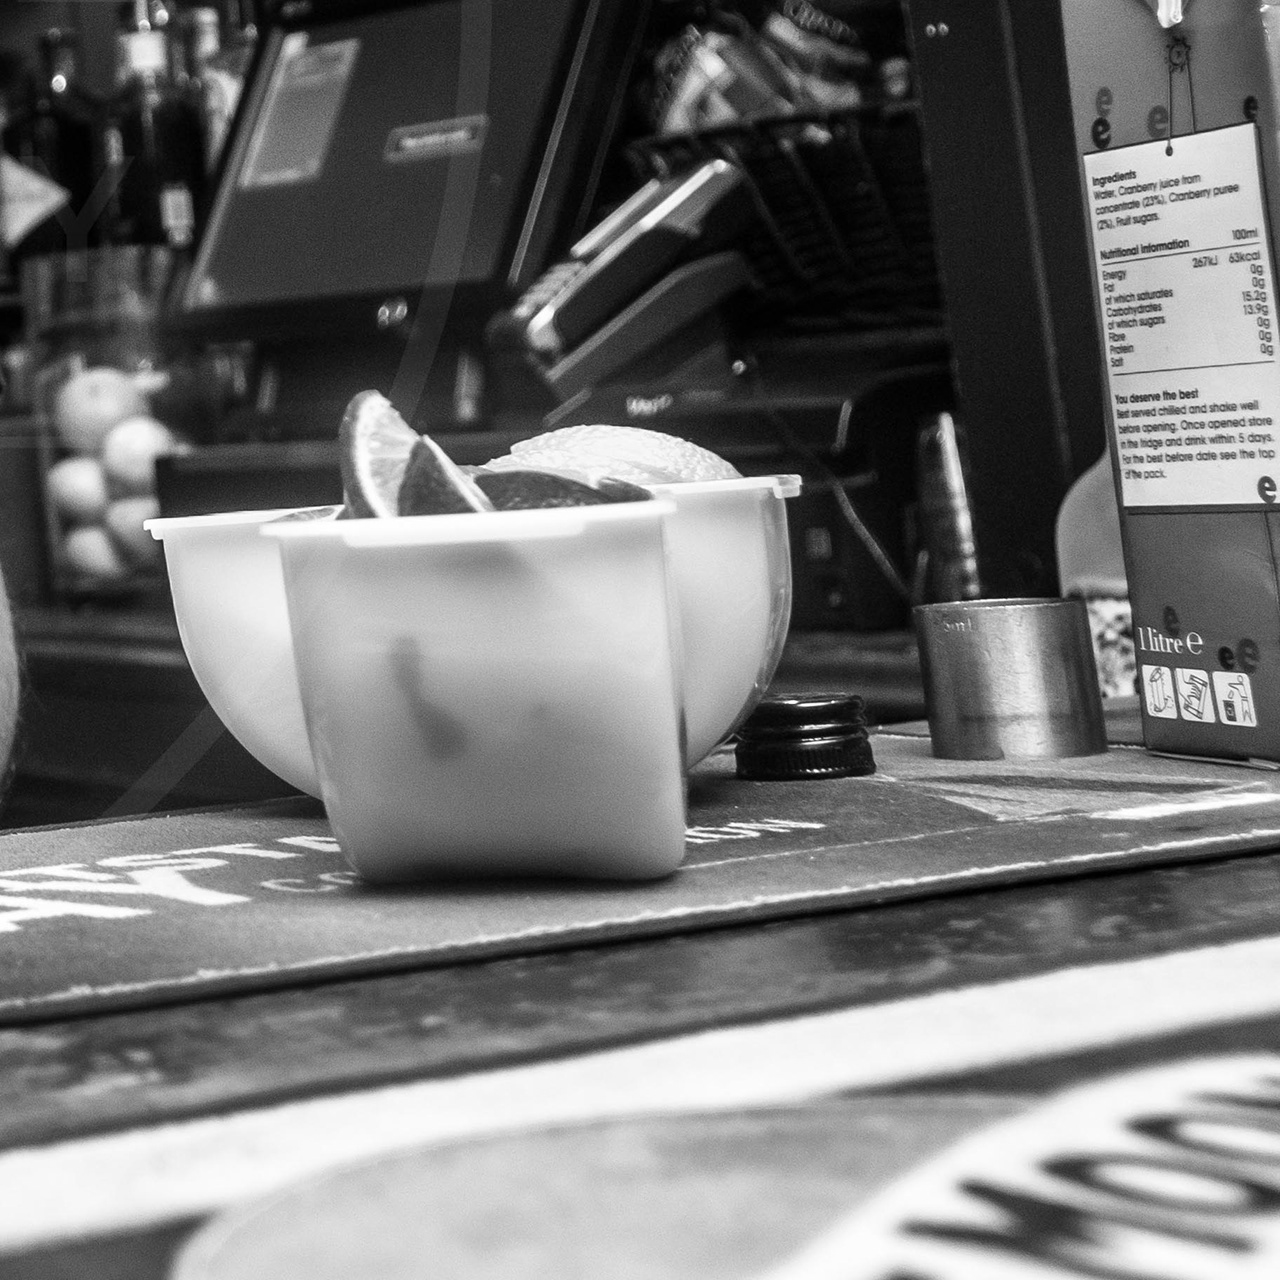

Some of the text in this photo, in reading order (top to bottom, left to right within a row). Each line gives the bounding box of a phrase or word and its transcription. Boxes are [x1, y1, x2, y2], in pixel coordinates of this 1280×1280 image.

[1092, 170, 1137, 187] Ingredients
[1118, 182, 1158, 196] Cranberry
[1159, 176, 1180, 190] juice
[1182, 173, 1201, 186] from
[1095, 200, 1140, 215] concentrate
[1169, 187, 1211, 203] Cranberry
[1116, 215, 1131, 227] Fruit
[1232, 228, 1258, 241] 100ml
[1100, 238, 1190, 261] Nutritional information
[1102, 250, 1261, 281] Energy 267kJ 63kcal
[1103, 264, 1263, 293] Fat 0g
[1105, 277, 1266, 306] of which saturates 0g
[1106, 291, 1267, 318] Carbohydrates 15.2g
[1108, 304, 1269, 331] of which sugars 13.9g
[1109, 317, 1271, 342] Fibre 0g
[1109, 330, 1272, 355] Protein 0g
[1111, 344, 1274, 368] Salt 0g
[1115, 388, 1199, 405] You deserve the best
[1116, 400, 1259, 419] Best served chilled and shake well
[1118, 416, 1273, 435] before opening. Once opened store
[1127, 439, 1138, 448] the
[1140, 437, 1163, 450] fridge
[1165, 436, 1182, 446] and
[1184, 435, 1207, 446] drink
[1209, 433, 1236, 444] within
[1238, 433, 1245, 443] 5
[1247, 433, 1275, 445] days.
[1122, 448, 1276, 465] For the best before date see the top
[1124, 468, 1167, 480] of the pack.
[1138, 627, 1146, 651] 1
[1147, 627, 1183, 654] litre
